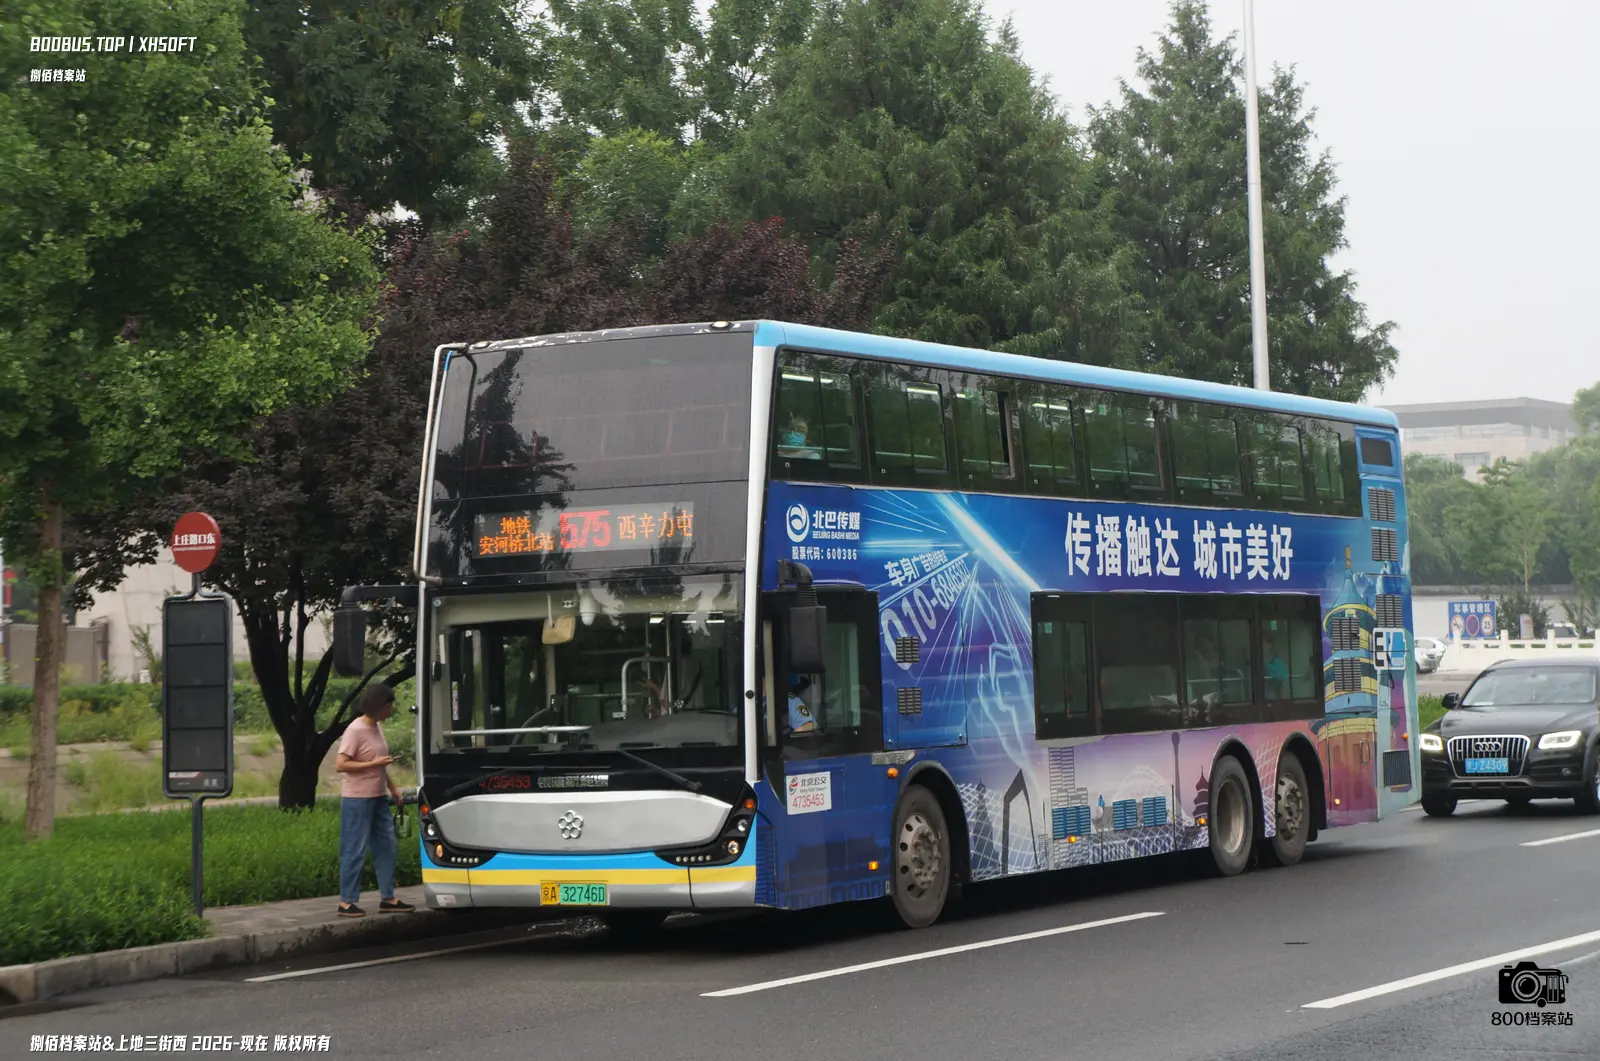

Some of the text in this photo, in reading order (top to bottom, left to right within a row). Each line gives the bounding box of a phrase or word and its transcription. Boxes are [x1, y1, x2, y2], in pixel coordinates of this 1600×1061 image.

[500, 516, 531, 534] 地铁
[559, 510, 611, 549] 575
[617, 510, 694, 540] 西辛力屯
[812, 510, 861, 530] 北巴传媒
[479, 531, 554, 555] 安河桥北站
[812, 531, 860, 540] BEIJING BASHI MEDIA
[1065, 511, 1293, 580] 传播触达 城市美好
[800, 776, 827, 787] 北京公交
[792, 793, 825, 808] 4735453
